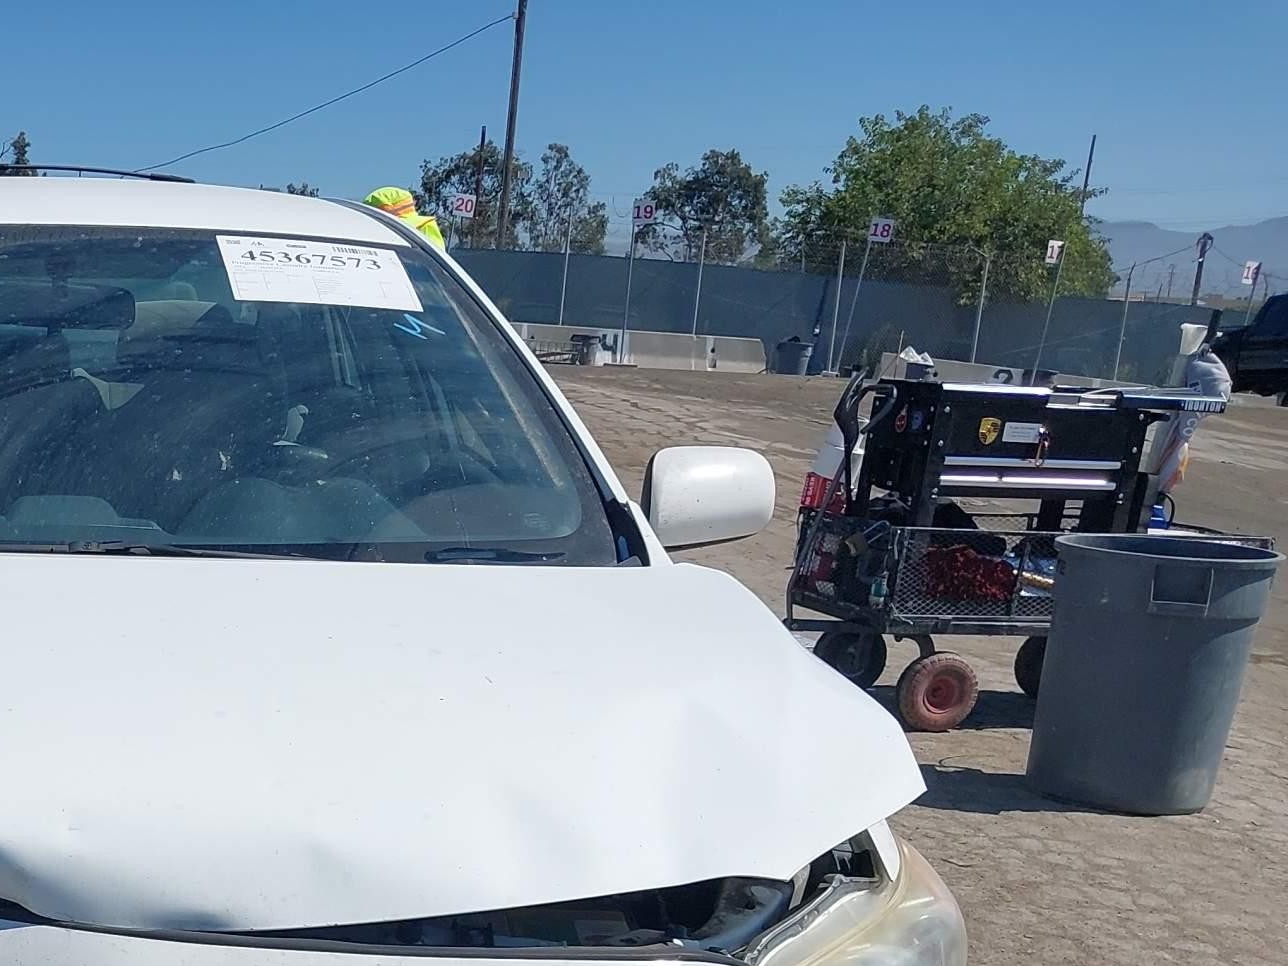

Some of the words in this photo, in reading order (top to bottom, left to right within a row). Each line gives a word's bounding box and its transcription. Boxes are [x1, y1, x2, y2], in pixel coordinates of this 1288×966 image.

[455, 198, 473, 213] 20
[633, 205, 653, 220] 19
[870, 223, 891, 238] 18
[241, 249, 381, 270] 45367573
